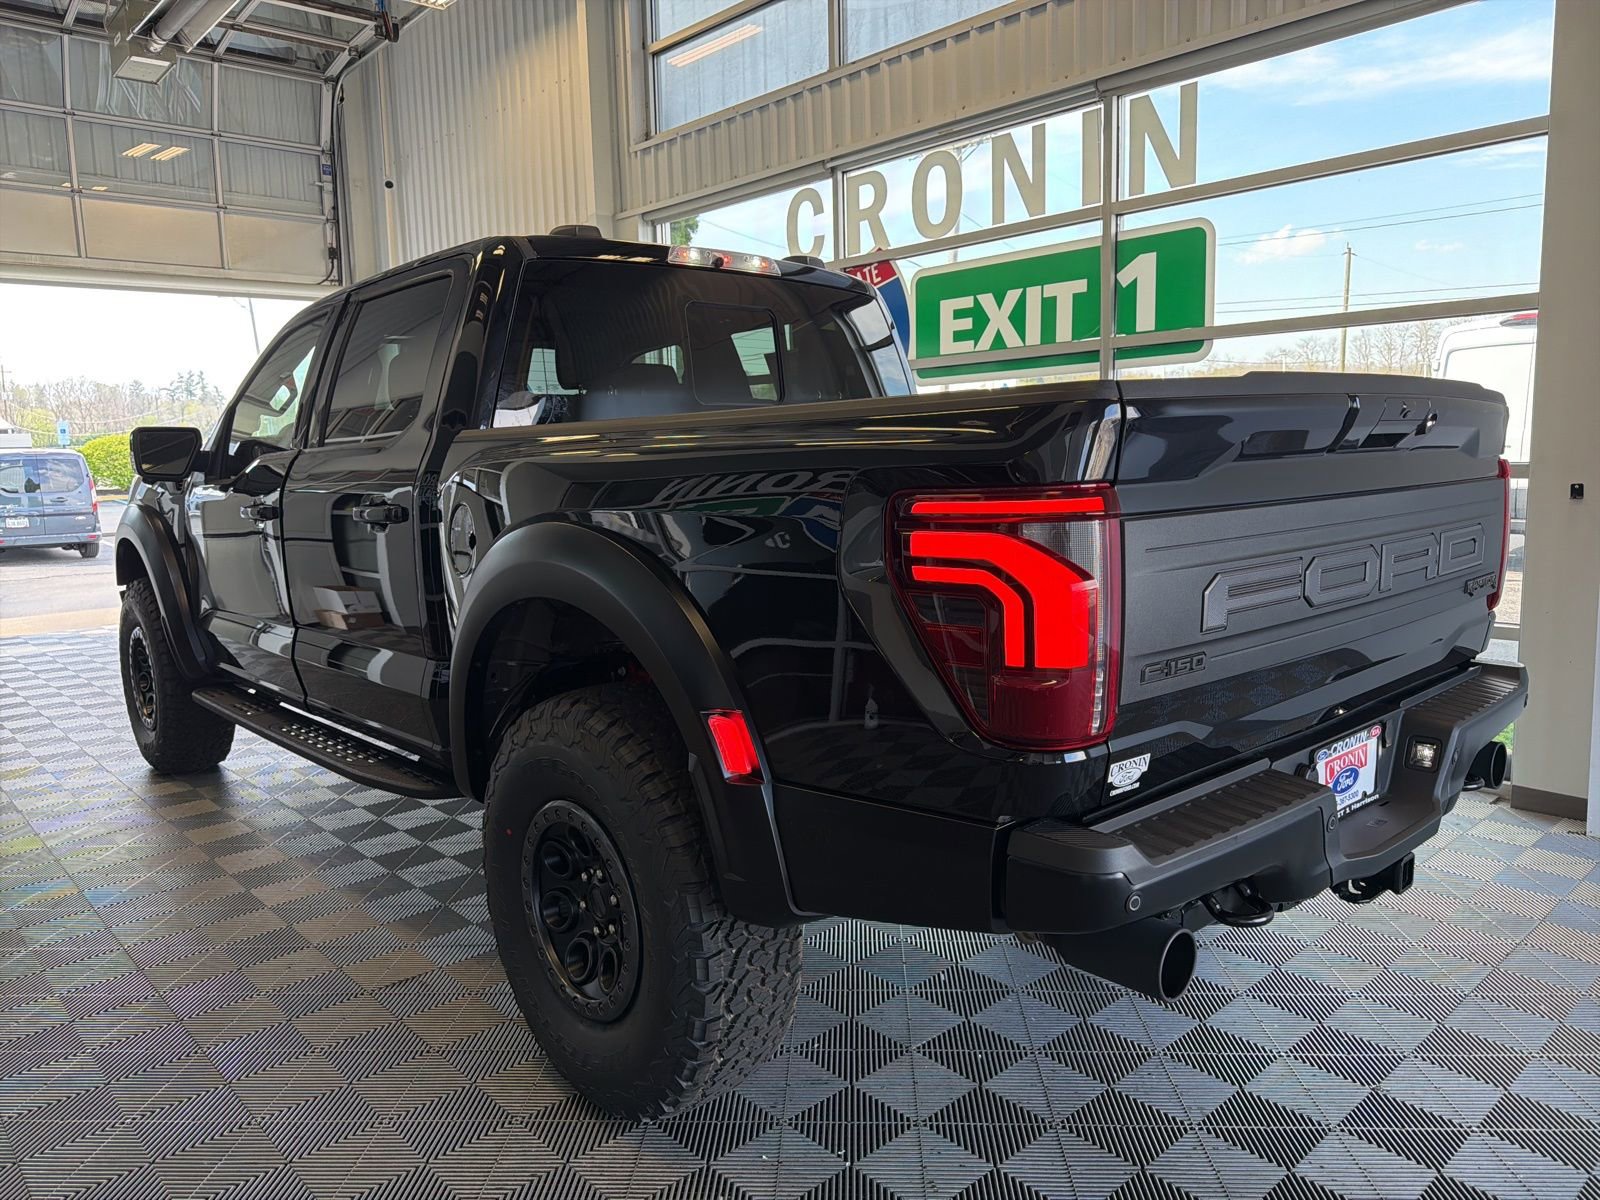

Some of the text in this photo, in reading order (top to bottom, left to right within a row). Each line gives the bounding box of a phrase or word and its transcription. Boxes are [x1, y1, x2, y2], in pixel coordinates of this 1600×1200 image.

[786, 80, 1198, 258] CRONIN
[940, 251, 1157, 356] EXIT 1
[1201, 523, 1485, 634] FORD
[1140, 651, 1207, 685] F-150
[1111, 756, 1149, 777] CRONIN
[1327, 747, 1367, 783] CRONIN
[1337, 770, 1355, 791] Ford
[1351, 794, 1379, 811] Harrison
